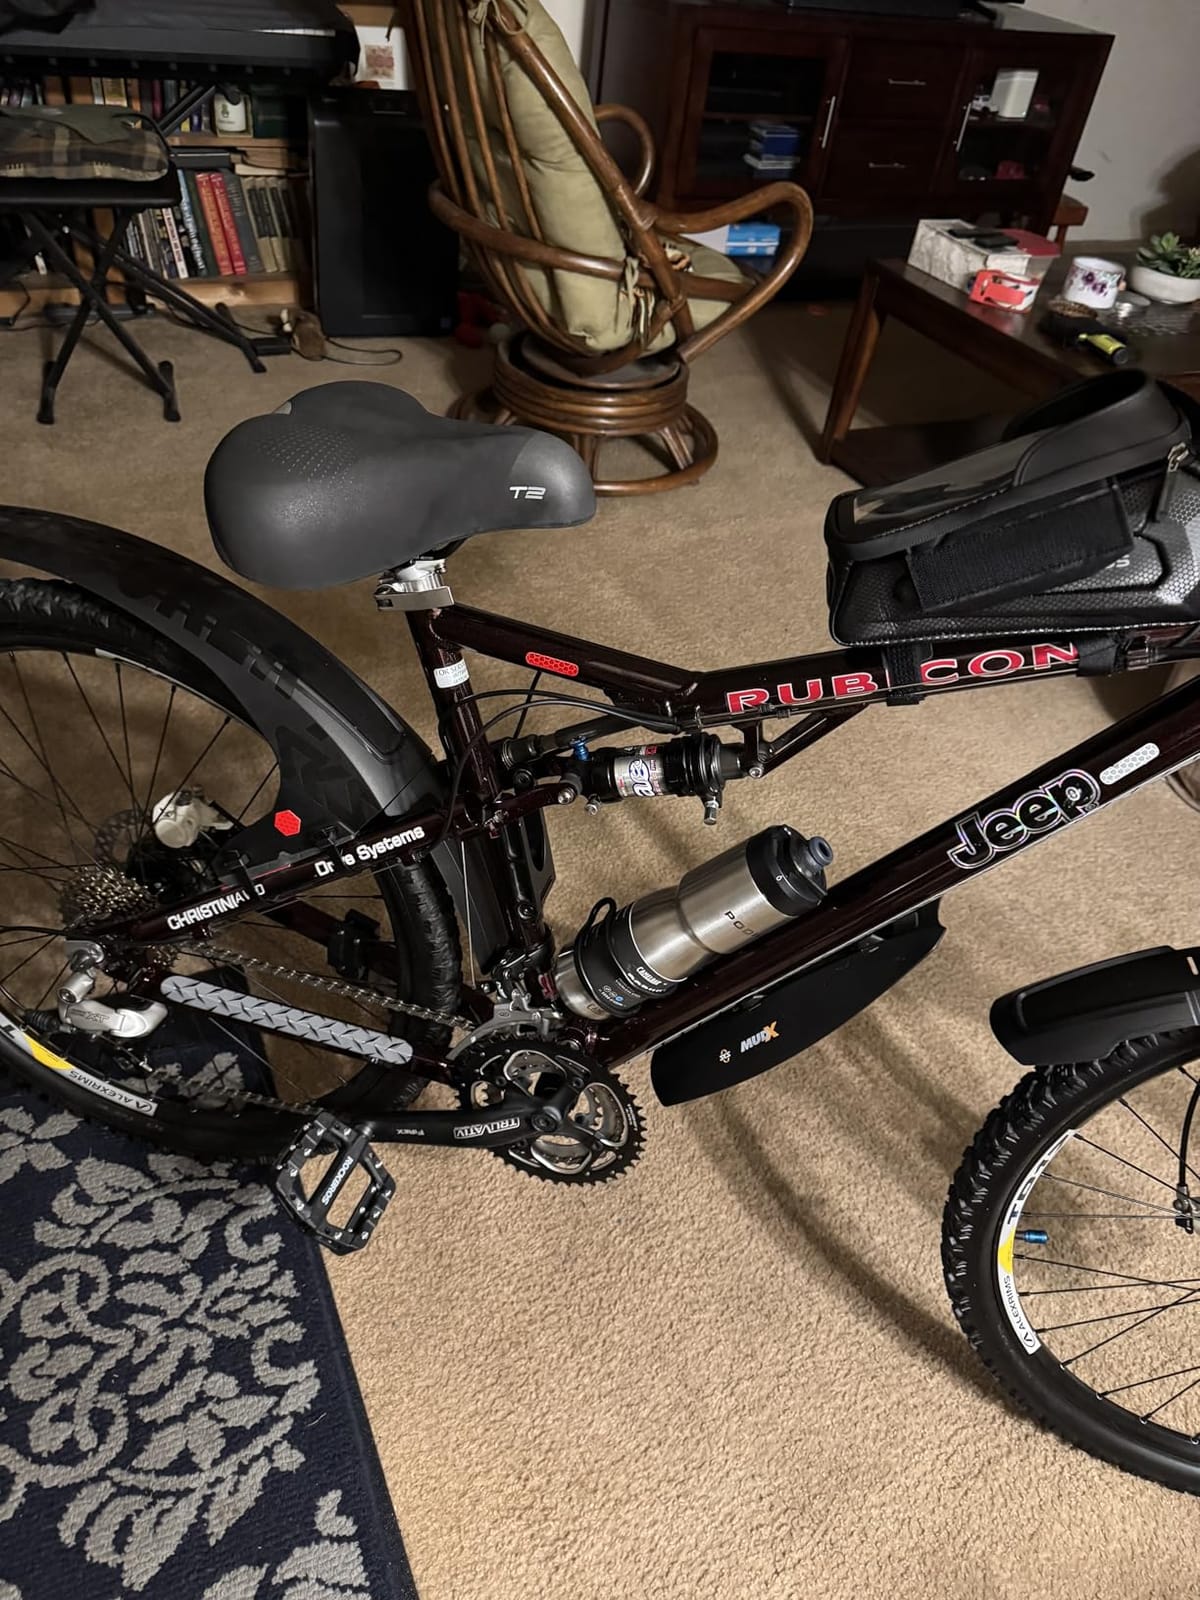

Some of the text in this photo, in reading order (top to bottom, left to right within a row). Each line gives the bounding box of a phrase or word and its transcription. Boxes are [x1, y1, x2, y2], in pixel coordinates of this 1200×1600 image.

[509, 486, 546, 500] T2
[726, 642, 1080, 716] RUBCON
[946, 768, 1101, 870] Jeep
[314, 826, 425, 877] Dre Systems
[69, 1070, 133, 1104] ALEXRIMS
[454, 1117, 520, 1139] TRUVATIV
[321, 1155, 354, 1206] ROCKBROS
[1003, 1275, 1024, 1330] ALEXRIMS
